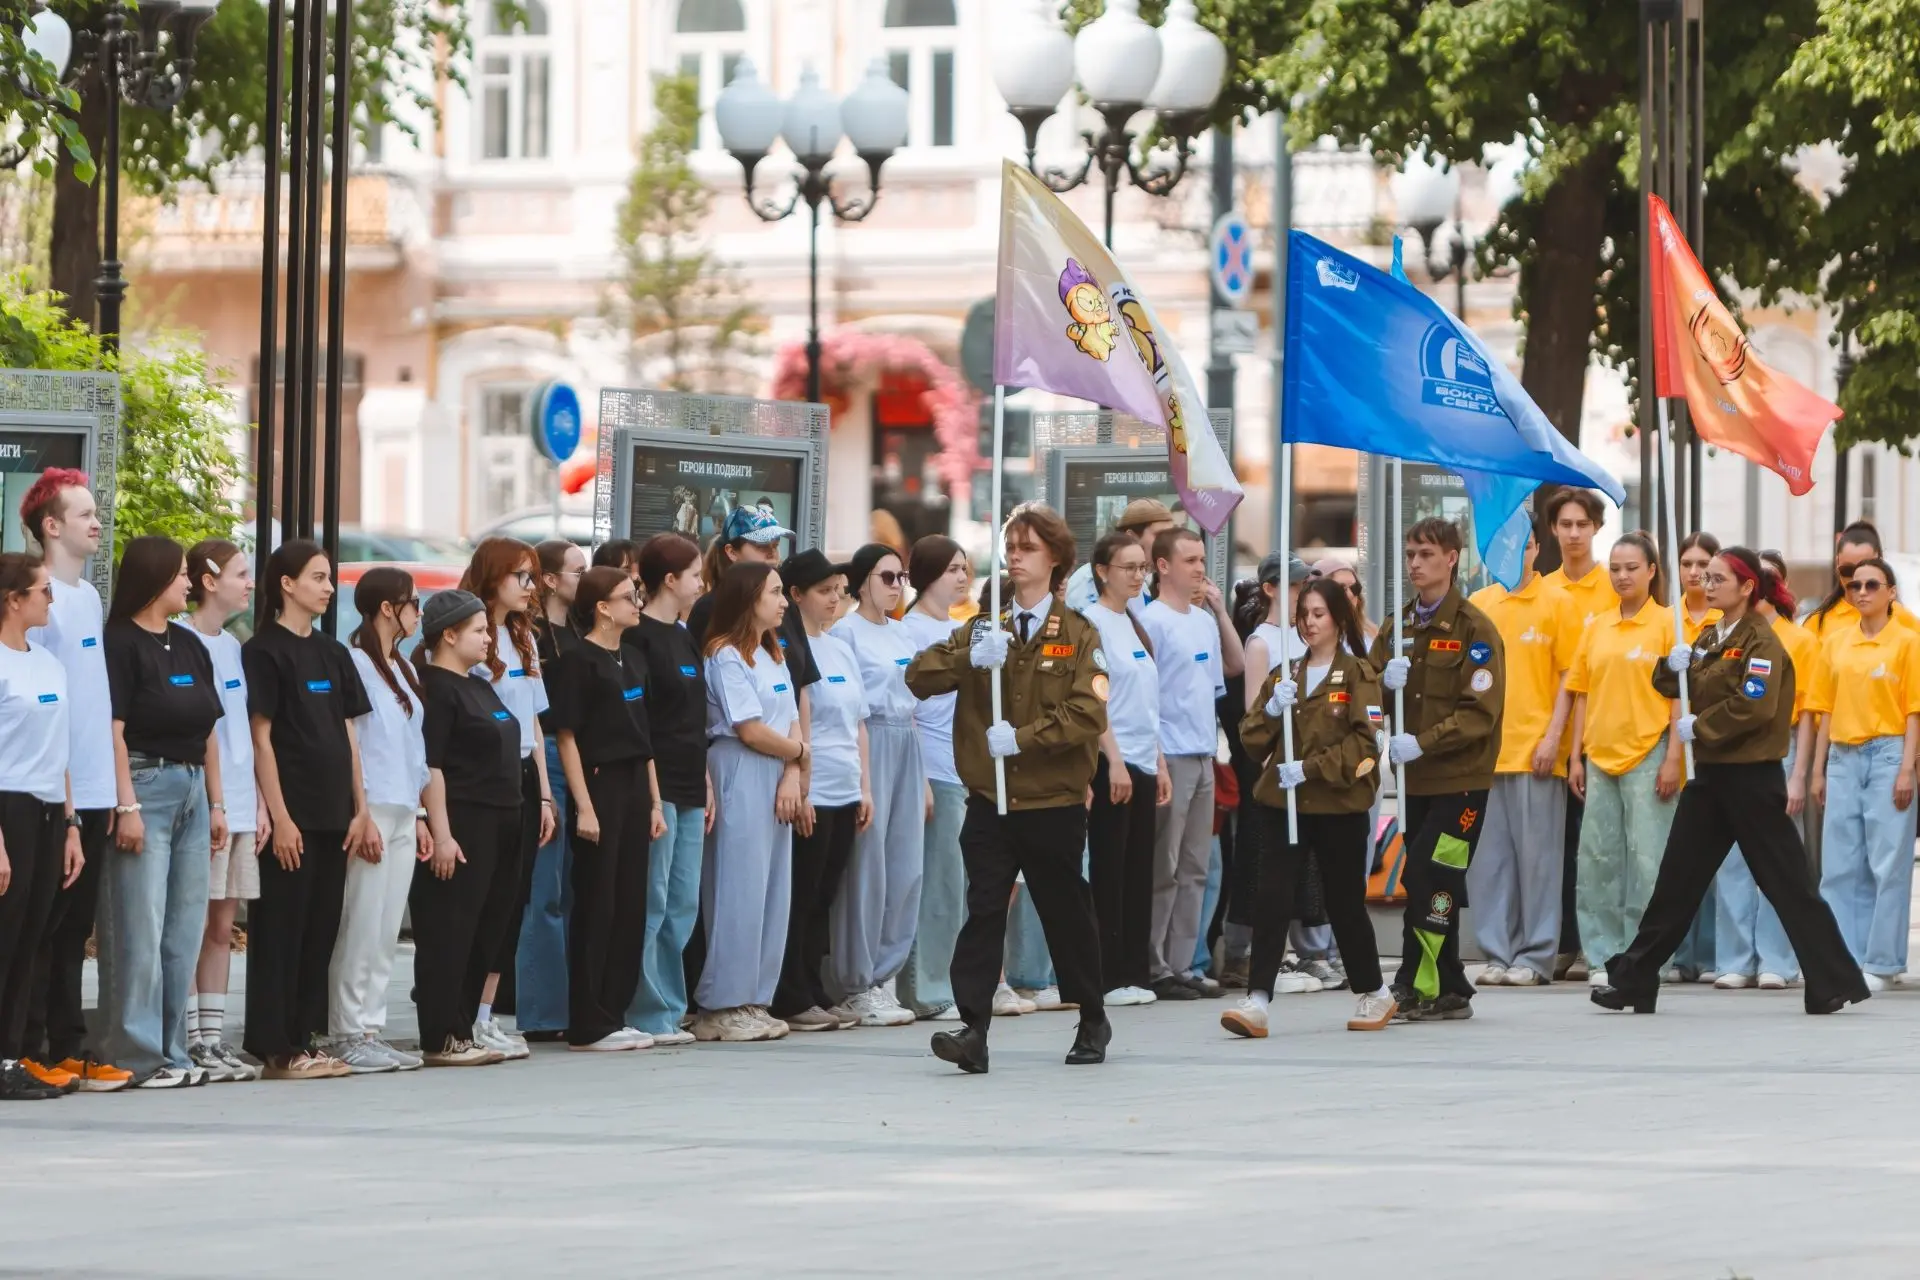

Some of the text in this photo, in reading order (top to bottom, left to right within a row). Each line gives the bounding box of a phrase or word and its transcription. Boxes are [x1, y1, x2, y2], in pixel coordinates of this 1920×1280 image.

[1436, 386, 1496, 404] ВОКРУ
[1443, 397, 1505, 416] СВЕТА
[679, 461, 752, 478] ГЕРОИ И ПОДВИГИ
[1104, 471, 1167, 485] ГЕРОИ И ПОДВИГИ
